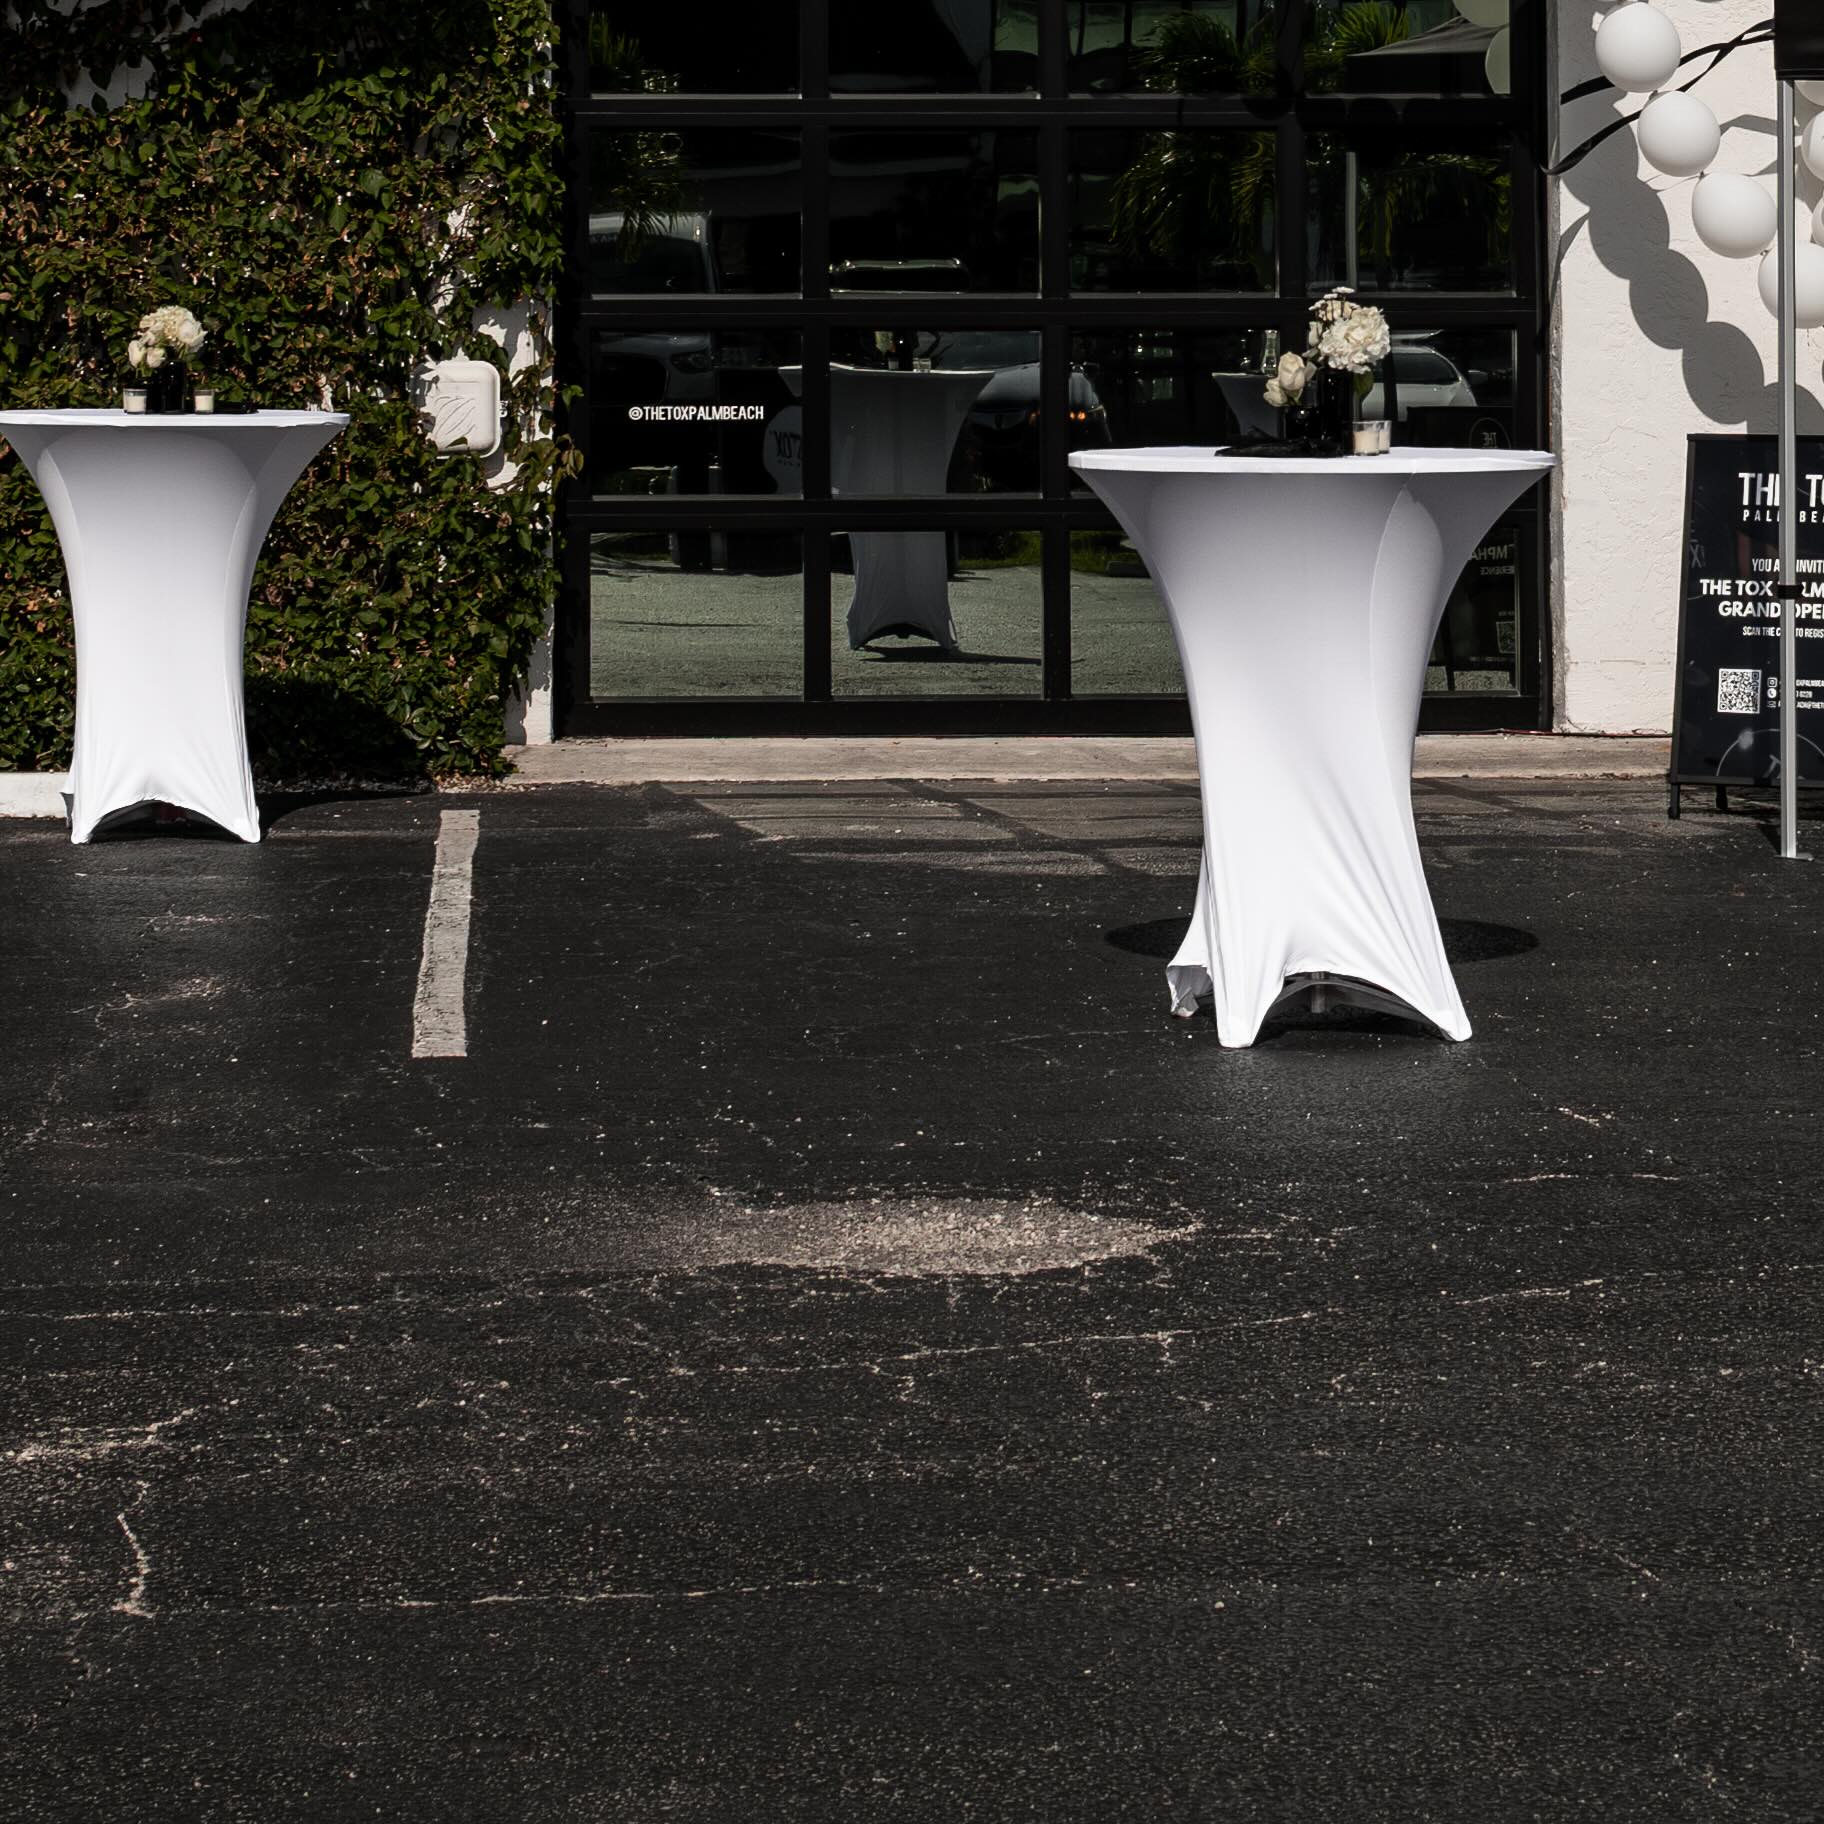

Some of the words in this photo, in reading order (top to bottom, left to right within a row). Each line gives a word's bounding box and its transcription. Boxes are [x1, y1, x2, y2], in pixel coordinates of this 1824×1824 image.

[628, 405, 764, 421] @THETOXPALMBEACH
[1743, 509, 1780, 522] PAL
[1752, 558, 1772, 572] YOU
[1699, 579, 1732, 596] THE
[1735, 580, 1773, 596] TOX
[1718, 600, 1781, 617] GRAND
[1742, 626, 1761, 636] SCAN
[1762, 626, 1775, 637] THE
